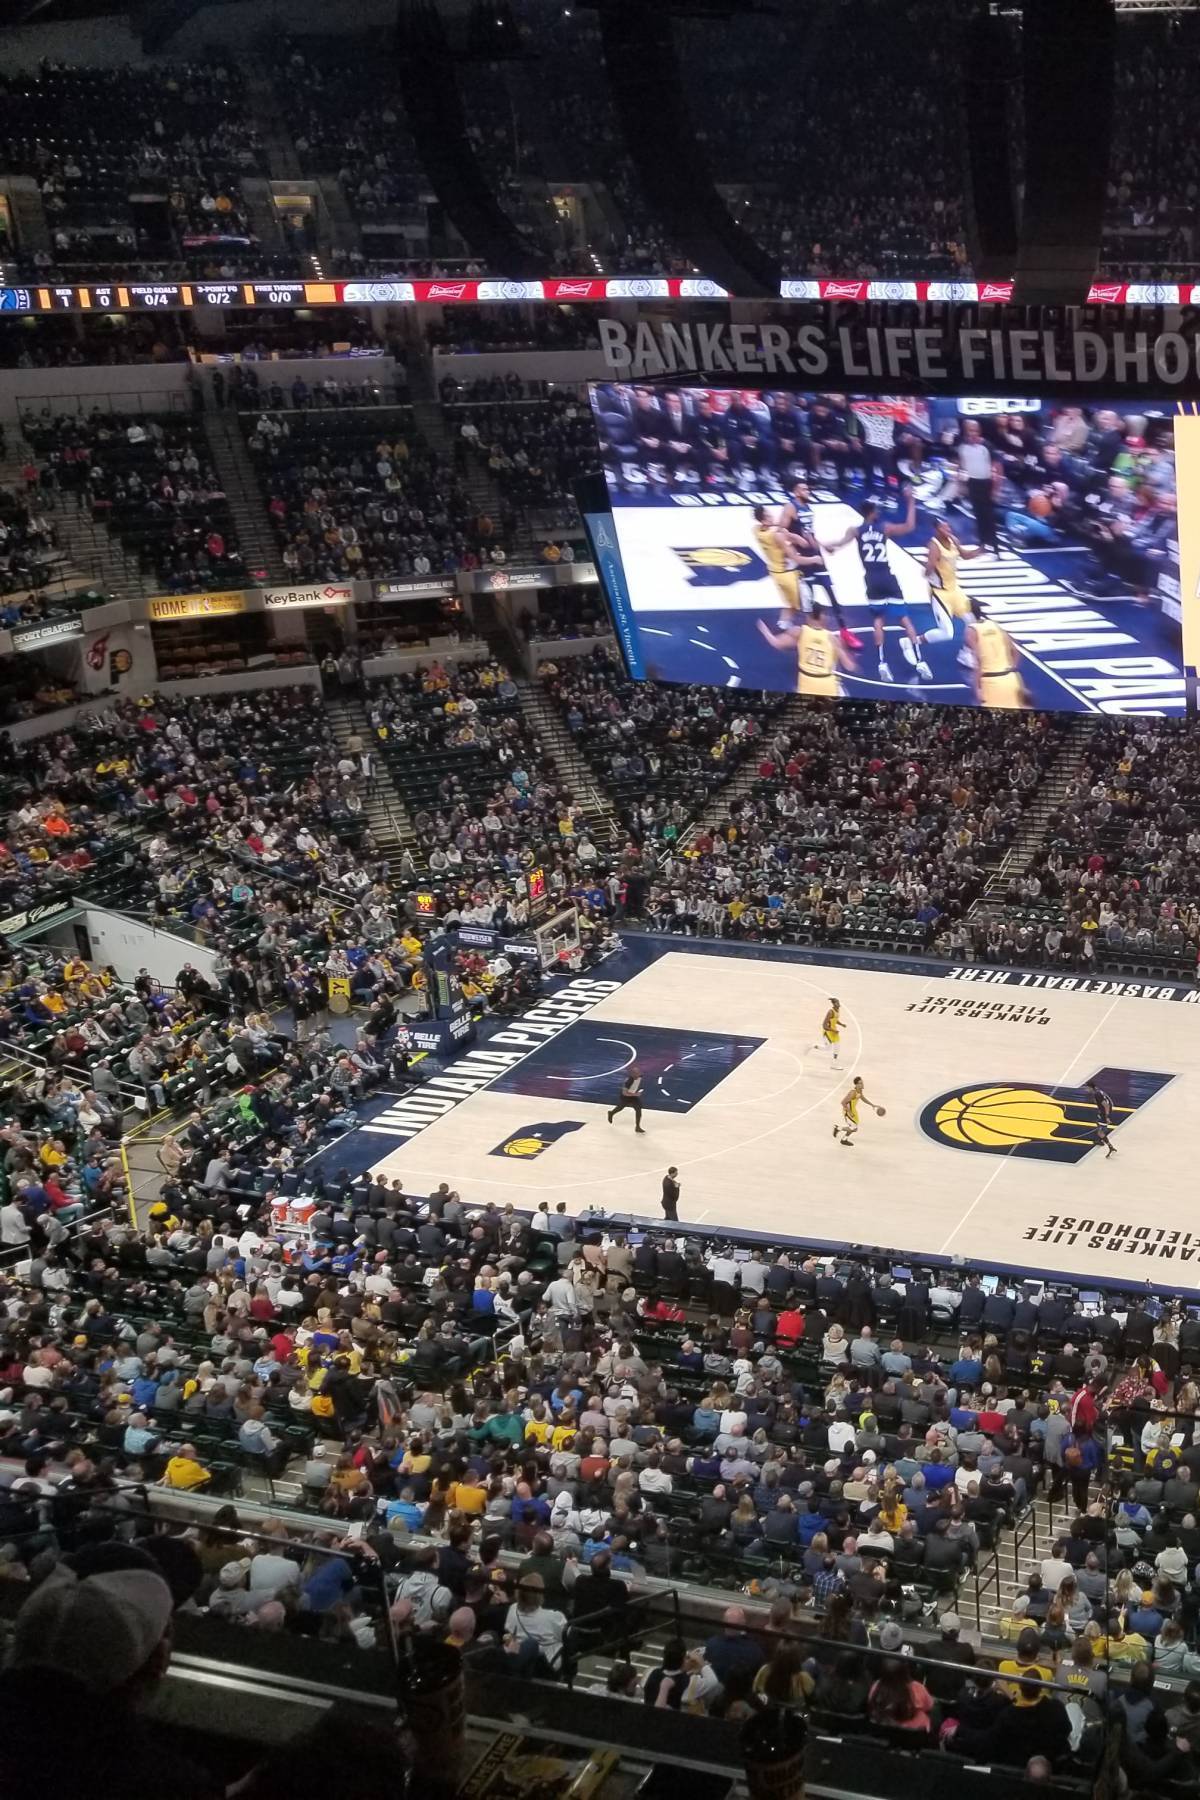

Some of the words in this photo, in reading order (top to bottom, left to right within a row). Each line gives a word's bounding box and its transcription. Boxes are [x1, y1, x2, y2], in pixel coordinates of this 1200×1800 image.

[61, 296, 69, 307] 1
[100, 296, 110, 306] 0
[144, 294, 169, 306] 0/4
[207, 293, 231, 304] 0/2
[268, 292, 292, 303] 0/0
[599, 320, 829, 376] BANKERS
[838, 326, 948, 379] LIFE
[861, 542, 888, 563] 22
[264, 590, 321, 606] KeyBank
[152, 600, 187, 617] HOME
[41, 619, 82, 638] GRAPHICS
[944, 966, 1018, 986] HERE
[1020, 972, 1182, 1002] BASKETBALL
[904, 1002, 951, 1017] LIFE
[922, 995, 1049, 1017] FIELDHOUSE
[449, 1011, 472, 1033] BELLE
[954, 1005, 1052, 1027] BANKERS
[413, 1031, 442, 1042] BELLE
[452, 1022, 470, 1040] TIRE
[416, 1040, 438, 1050] TIRE
[359, 1049, 528, 1137] INDIANA
[487, 977, 623, 1048] PACERS
[1022, 1226, 1078, 1246] LIFE
